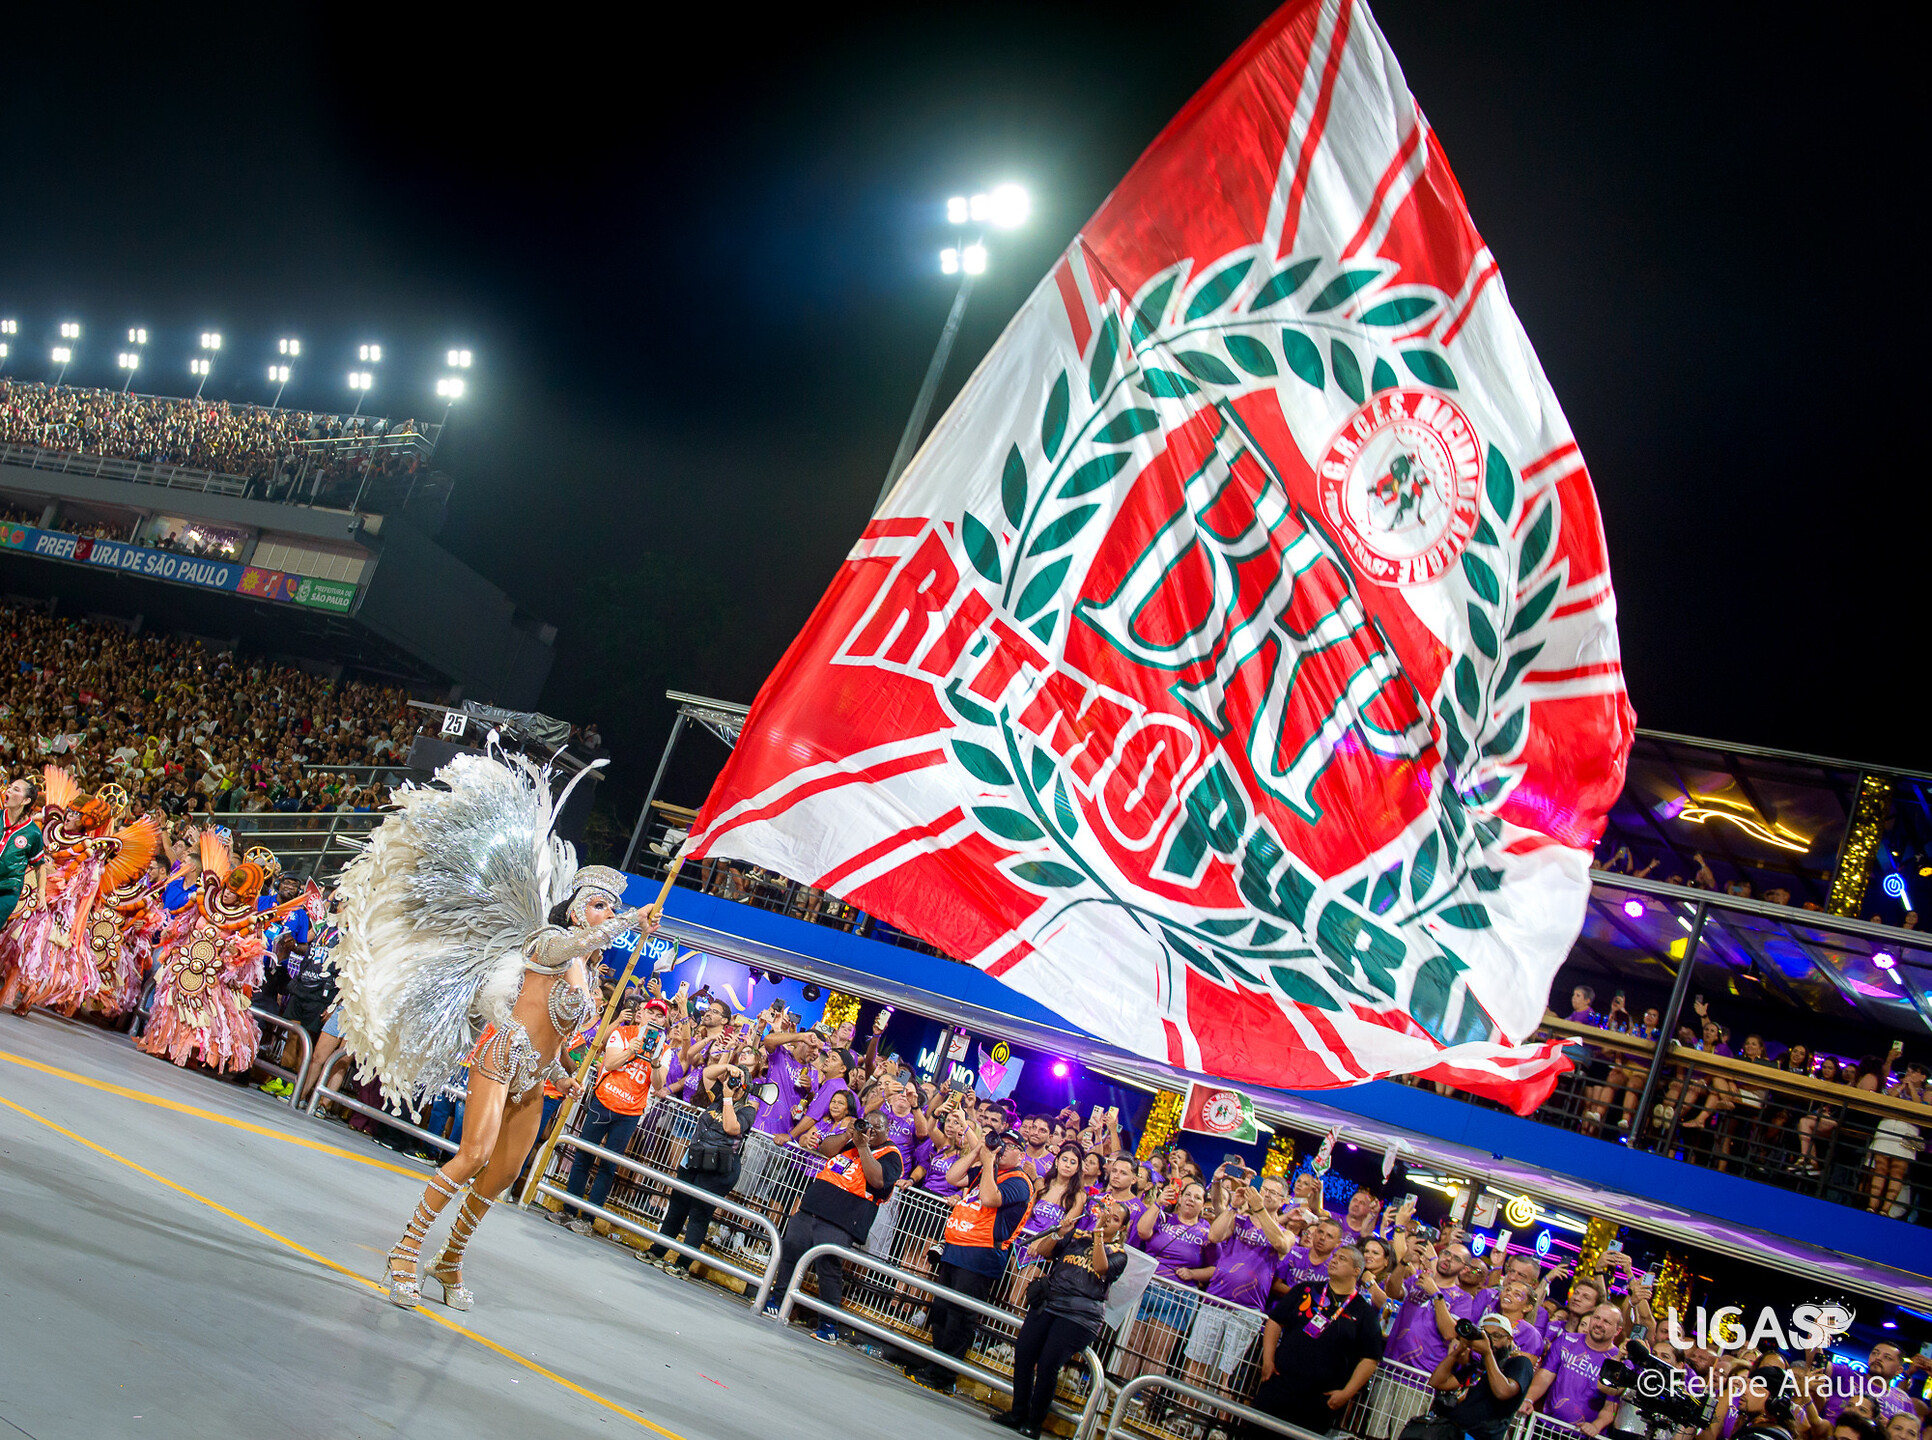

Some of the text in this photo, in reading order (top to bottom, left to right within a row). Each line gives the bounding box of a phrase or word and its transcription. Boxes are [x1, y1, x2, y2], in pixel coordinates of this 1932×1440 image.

[1397, 517, 1474, 585] ALEGRE
[122, 549, 144, 570] DE
[145, 552, 176, 578] SÃO
[177, 562, 230, 587] PAULO
[310, 591, 350, 607] SÃO PAULO
[314, 584, 345, 597] PREFEITURA
[836, 524, 1199, 850] RITMO
[445, 714, 463, 734] 25
[604, 1082, 635, 1104] CARNAVAL
